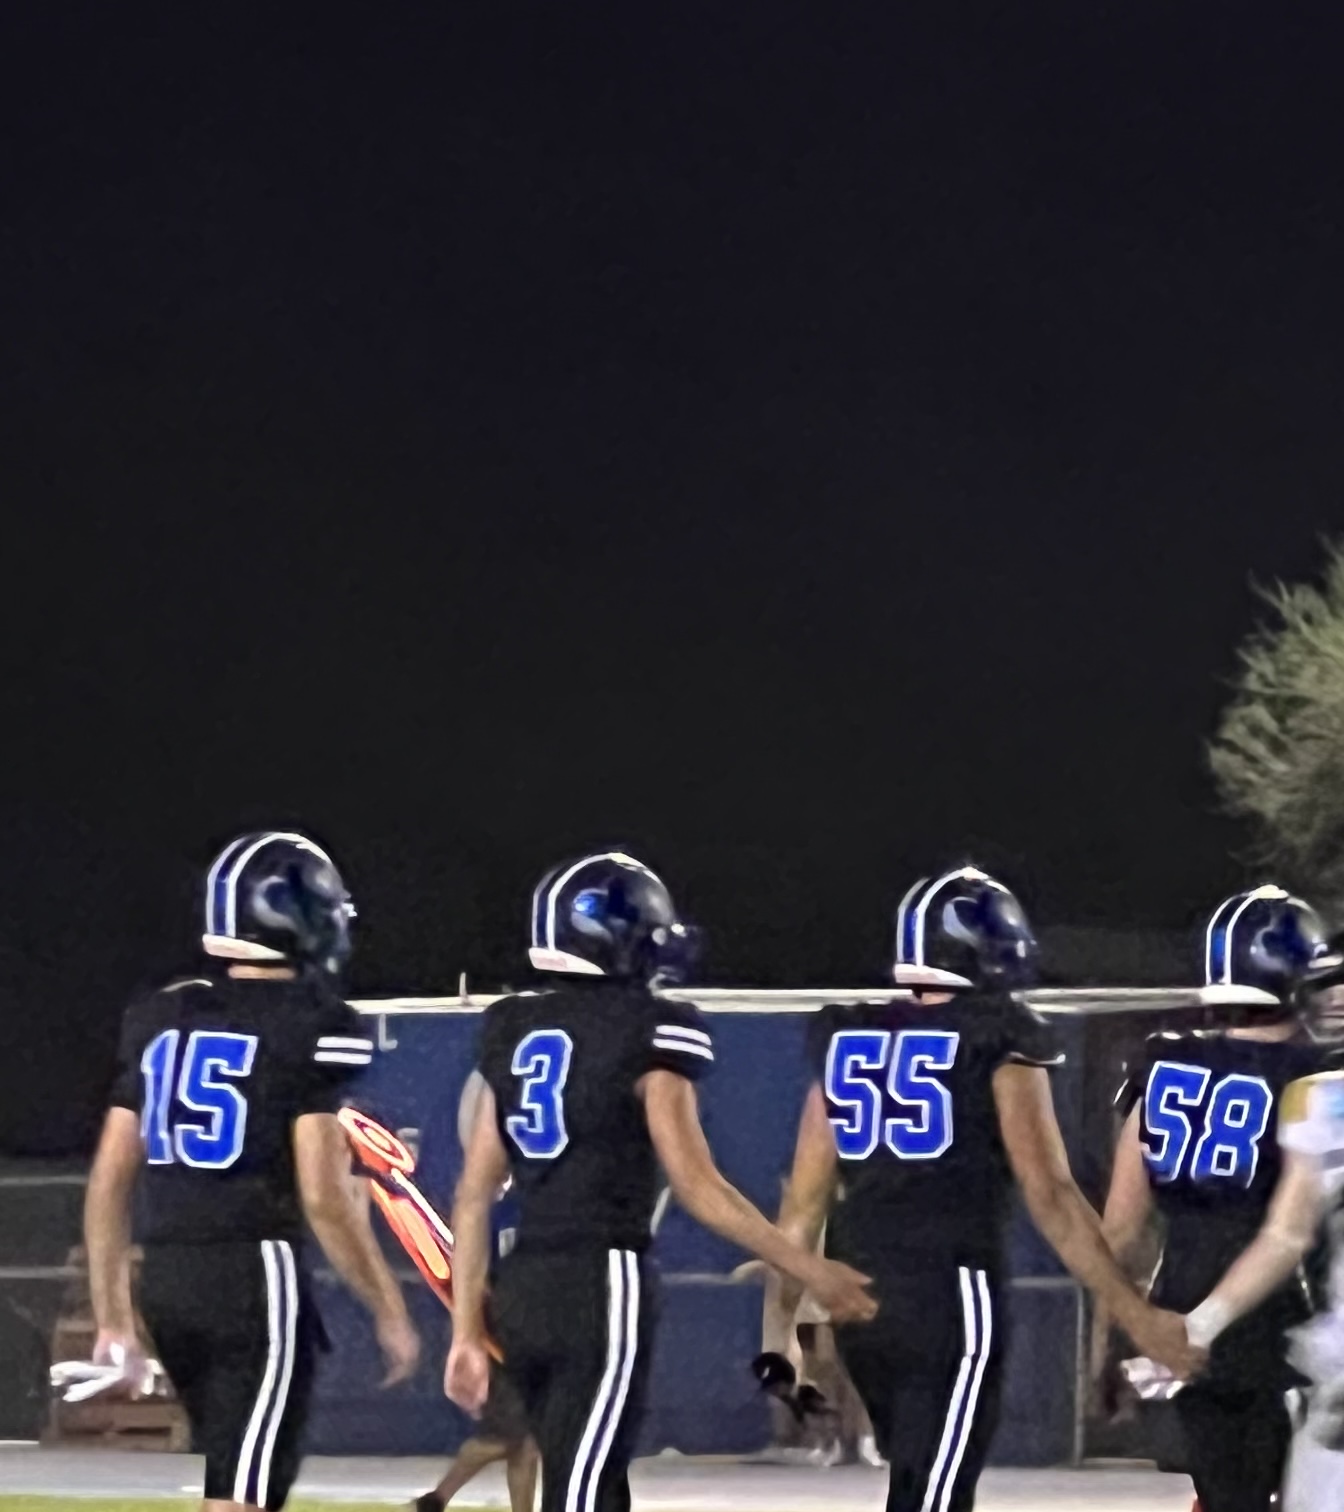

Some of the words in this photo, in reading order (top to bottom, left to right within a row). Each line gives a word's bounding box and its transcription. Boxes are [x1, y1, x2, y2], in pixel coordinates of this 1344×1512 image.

[140, 1030, 258, 1169] 15
[507, 1029, 574, 1160] 3
[825, 1031, 959, 1160] 55
[1141, 1061, 1273, 1189] 58
